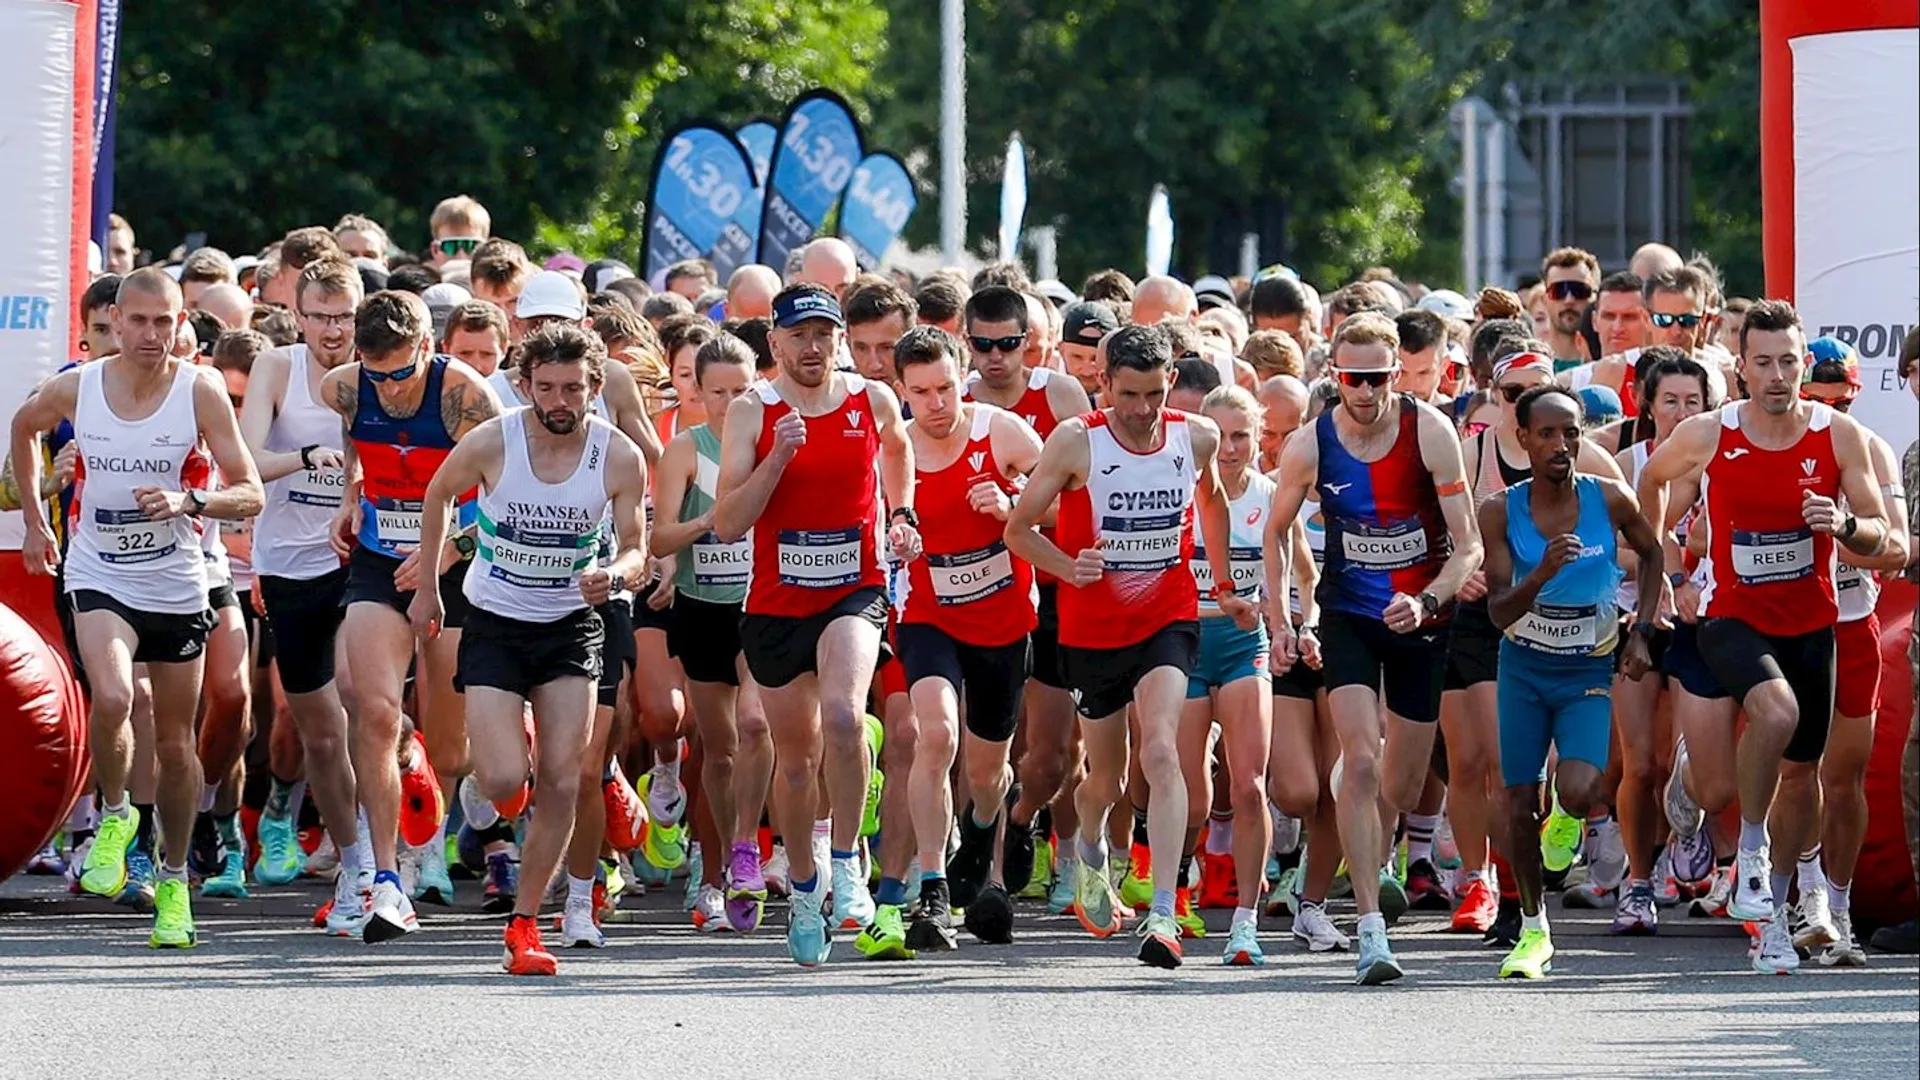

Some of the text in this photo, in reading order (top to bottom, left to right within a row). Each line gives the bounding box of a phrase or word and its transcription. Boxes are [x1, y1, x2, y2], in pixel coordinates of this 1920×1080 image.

[88, 455, 172, 474] ENGLAND
[589, 444, 600, 471] soar
[1108, 487, 1183, 511] CYMRU
[507, 501, 590, 521] SWANSEA
[117, 531, 156, 552] 322
[1103, 534, 1179, 551] MATTHEWS
[1348, 537, 1422, 554] LOCKLEY
[494, 545, 573, 568] GRIFFITHS
[781, 549, 858, 567] RODERICK
[1753, 550, 1796, 565] REES
[949, 565, 991, 586] COLE
[1527, 619, 1581, 638] AHMED
